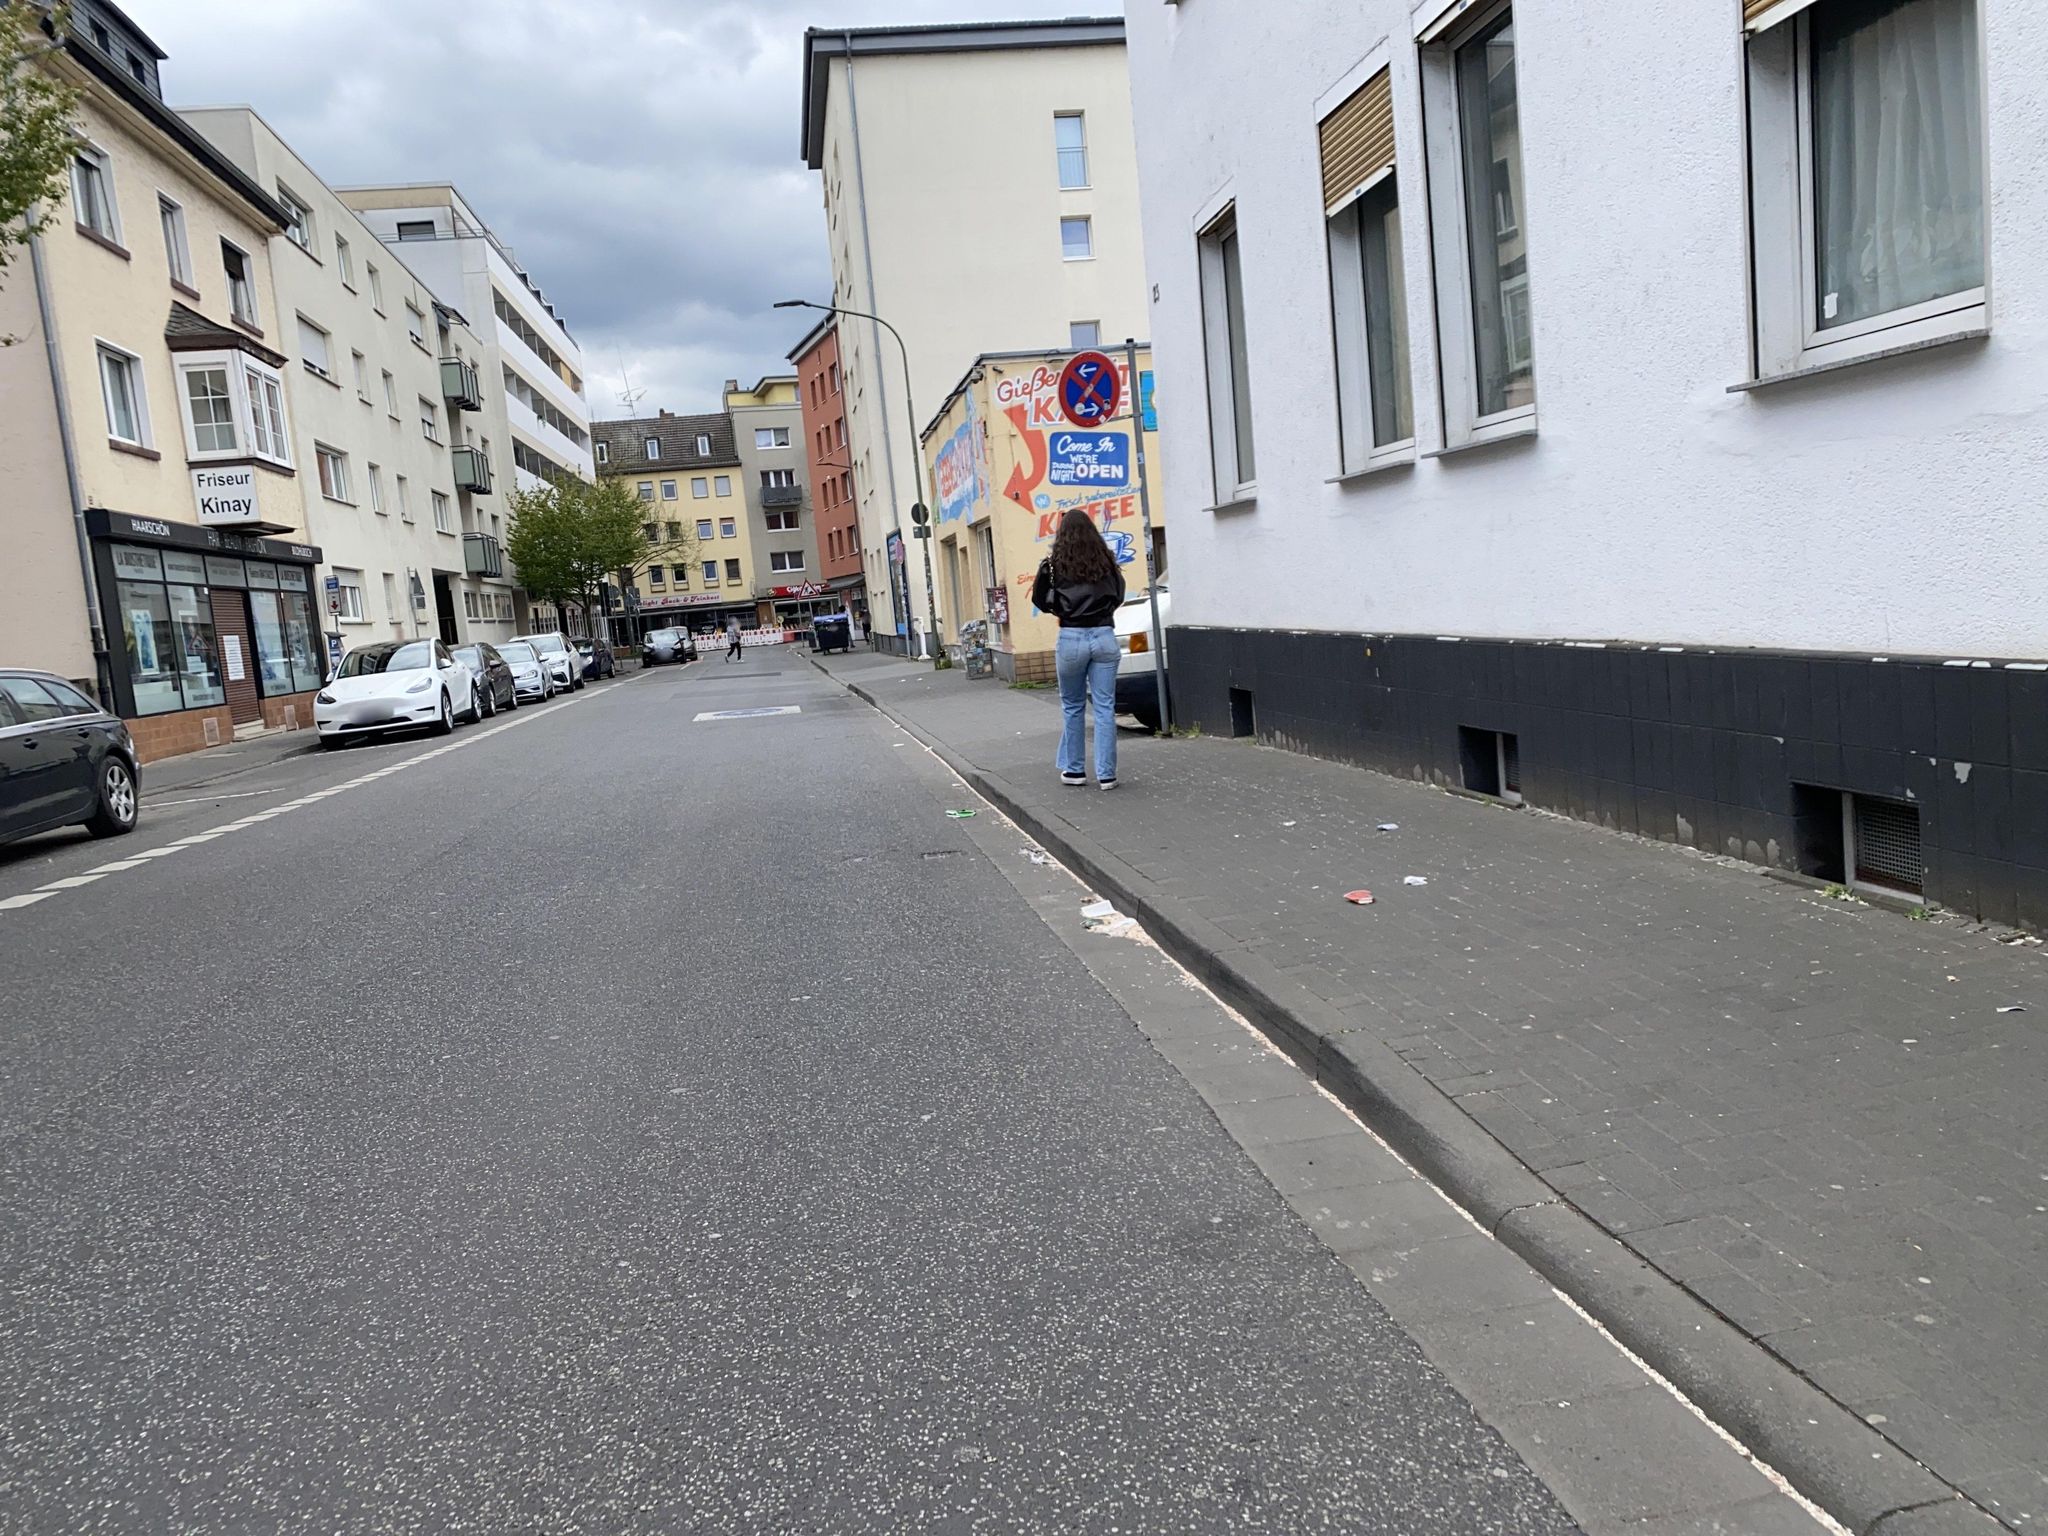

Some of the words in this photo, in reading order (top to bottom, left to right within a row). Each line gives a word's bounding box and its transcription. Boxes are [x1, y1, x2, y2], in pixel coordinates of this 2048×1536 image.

[1057, 435, 1093, 455] Come
[1094, 436, 1116, 452] In
[1069, 454, 1099, 464] WE'RE
[1076, 464, 1124, 479] OPEN
[196, 472, 250, 487] Friseur
[201, 497, 252, 516] Kinay
[1038, 495, 1135, 538] KFEE
[331, 639, 337, 647] P
